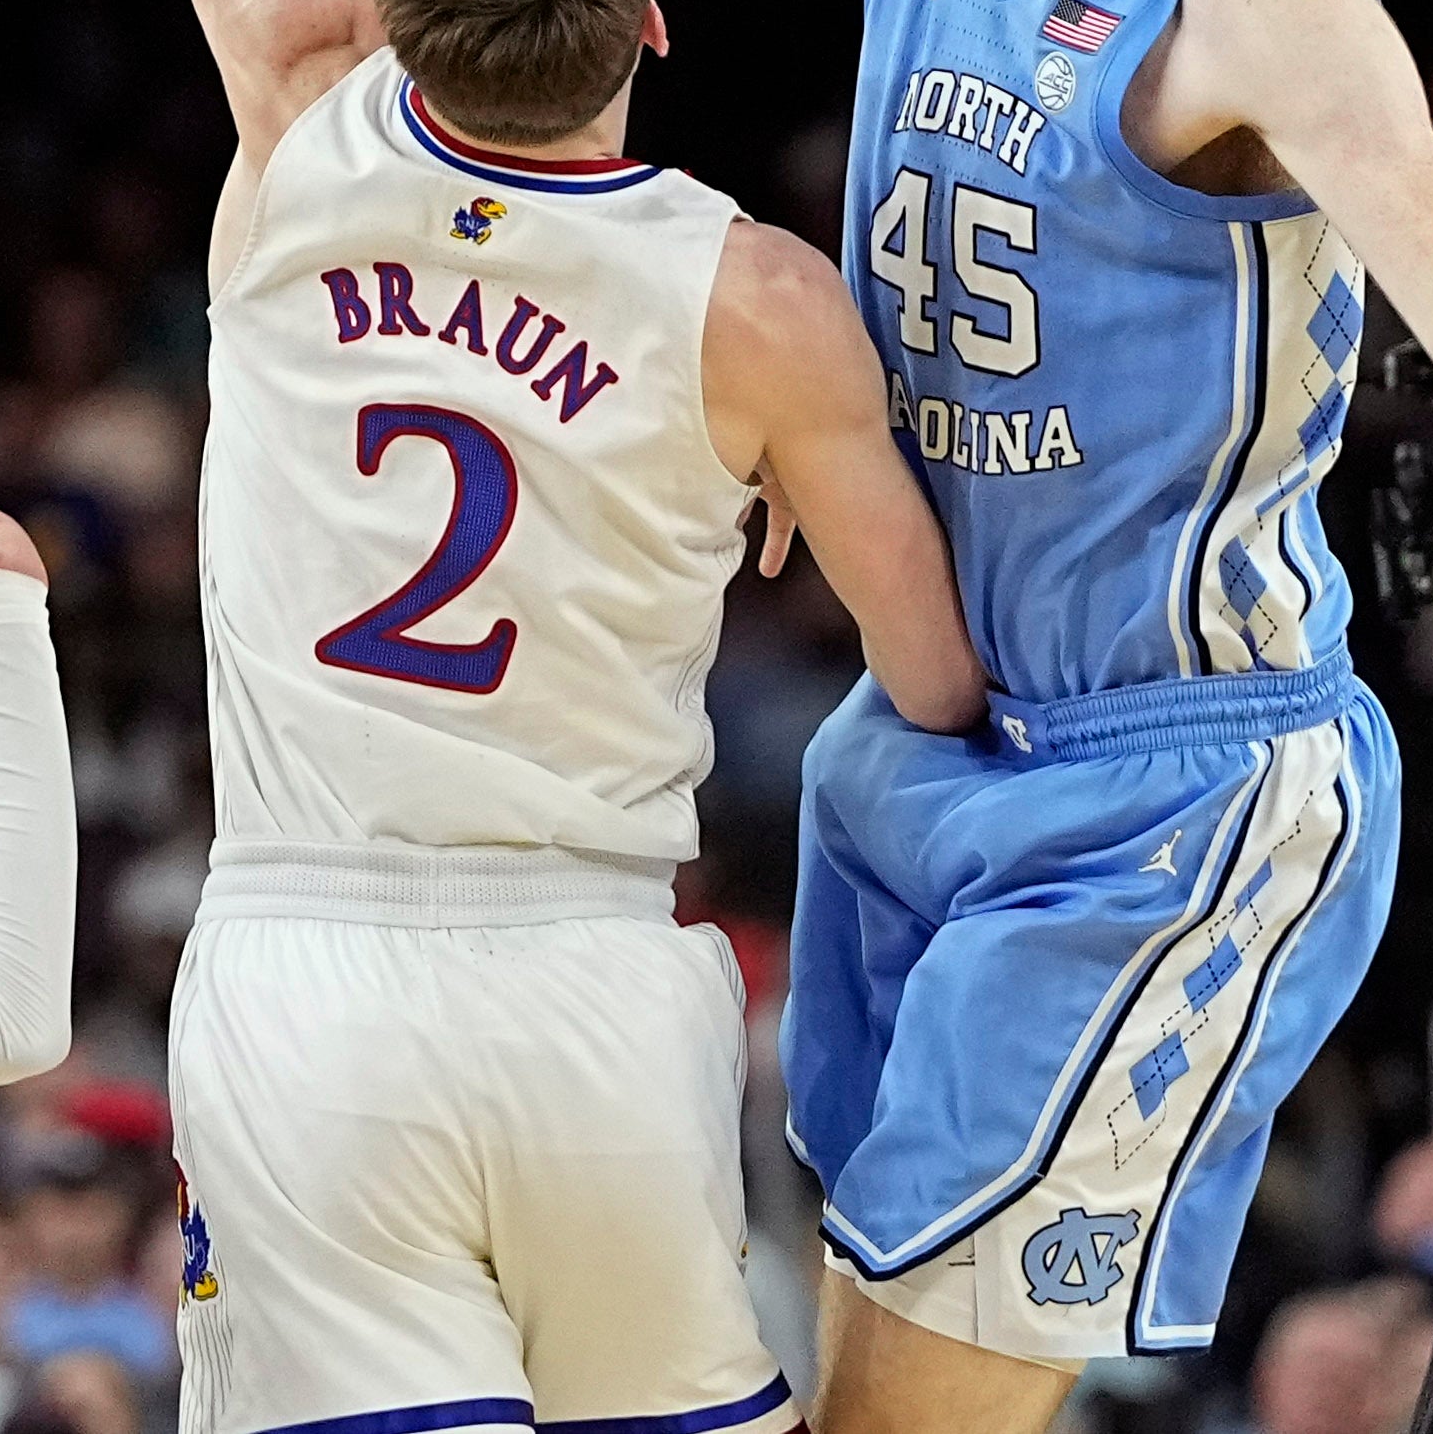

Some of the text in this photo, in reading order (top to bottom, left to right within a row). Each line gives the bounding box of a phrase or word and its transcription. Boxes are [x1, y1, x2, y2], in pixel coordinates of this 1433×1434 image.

[321, 261, 618, 424] BRAUN
[870, 164, 1041, 379] 45
[889, 369, 1085, 476] AOLINA
[314, 403, 518, 695] 2
